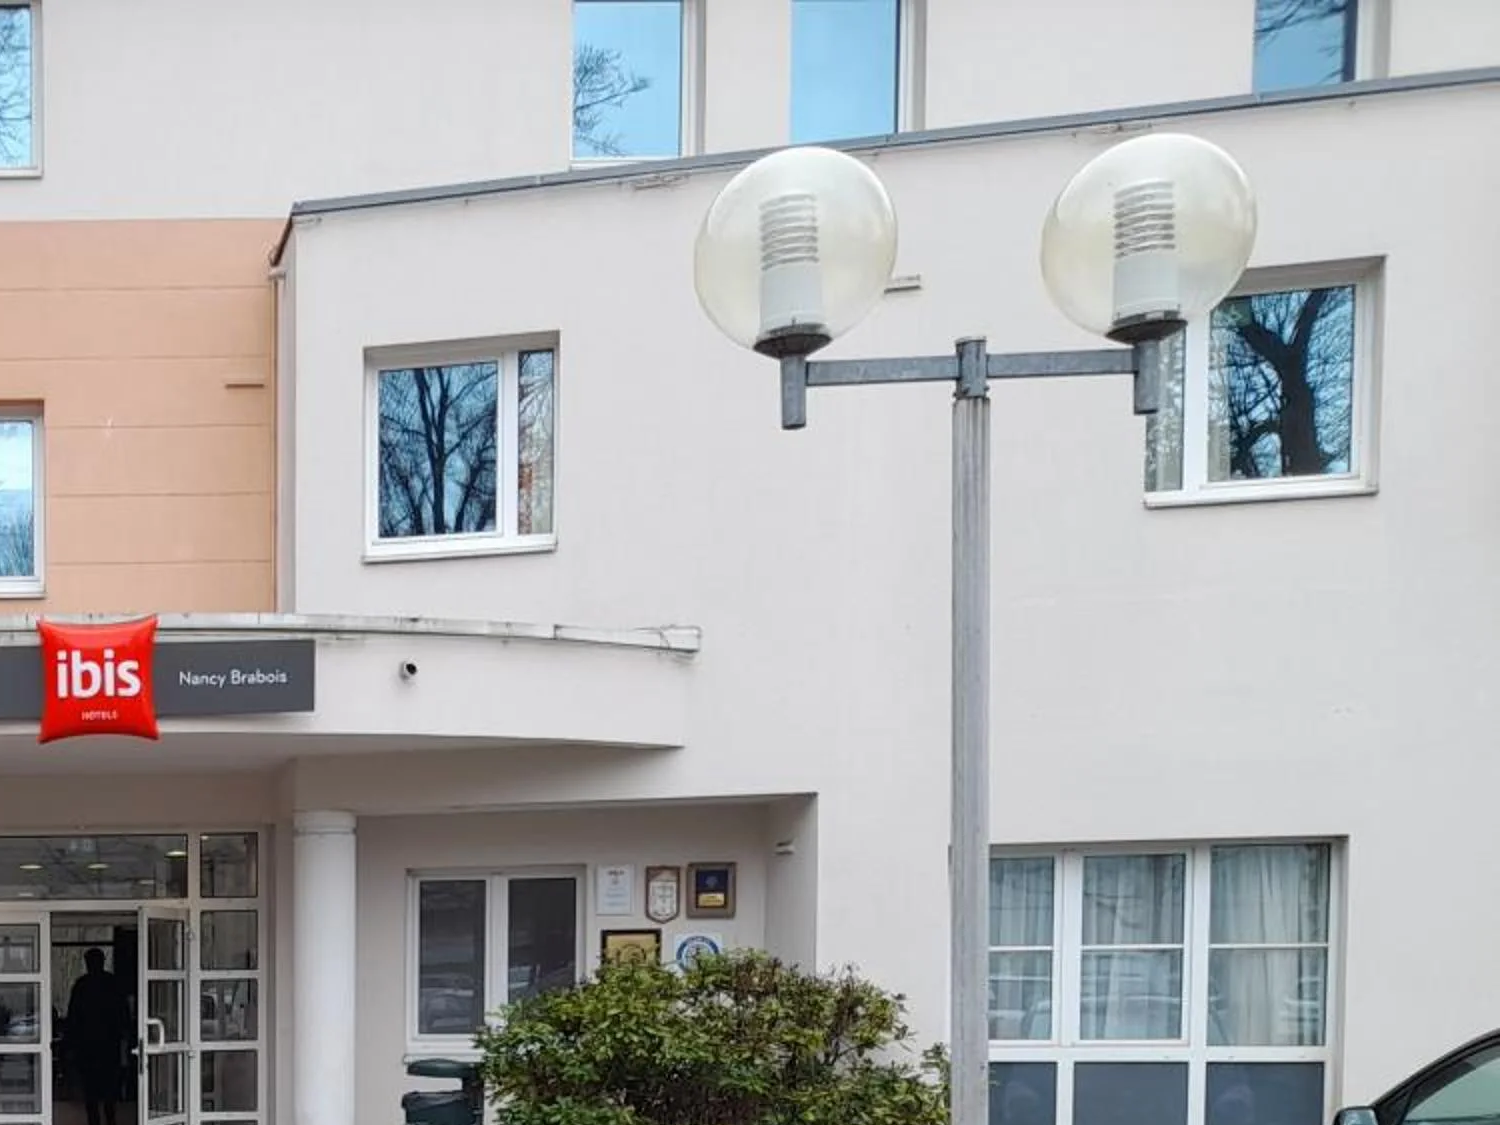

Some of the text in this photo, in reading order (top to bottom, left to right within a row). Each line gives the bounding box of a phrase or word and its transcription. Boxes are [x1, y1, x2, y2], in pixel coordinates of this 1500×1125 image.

[57, 648, 141, 699] ibis
[179, 668, 288, 688] Nancy Brabois
